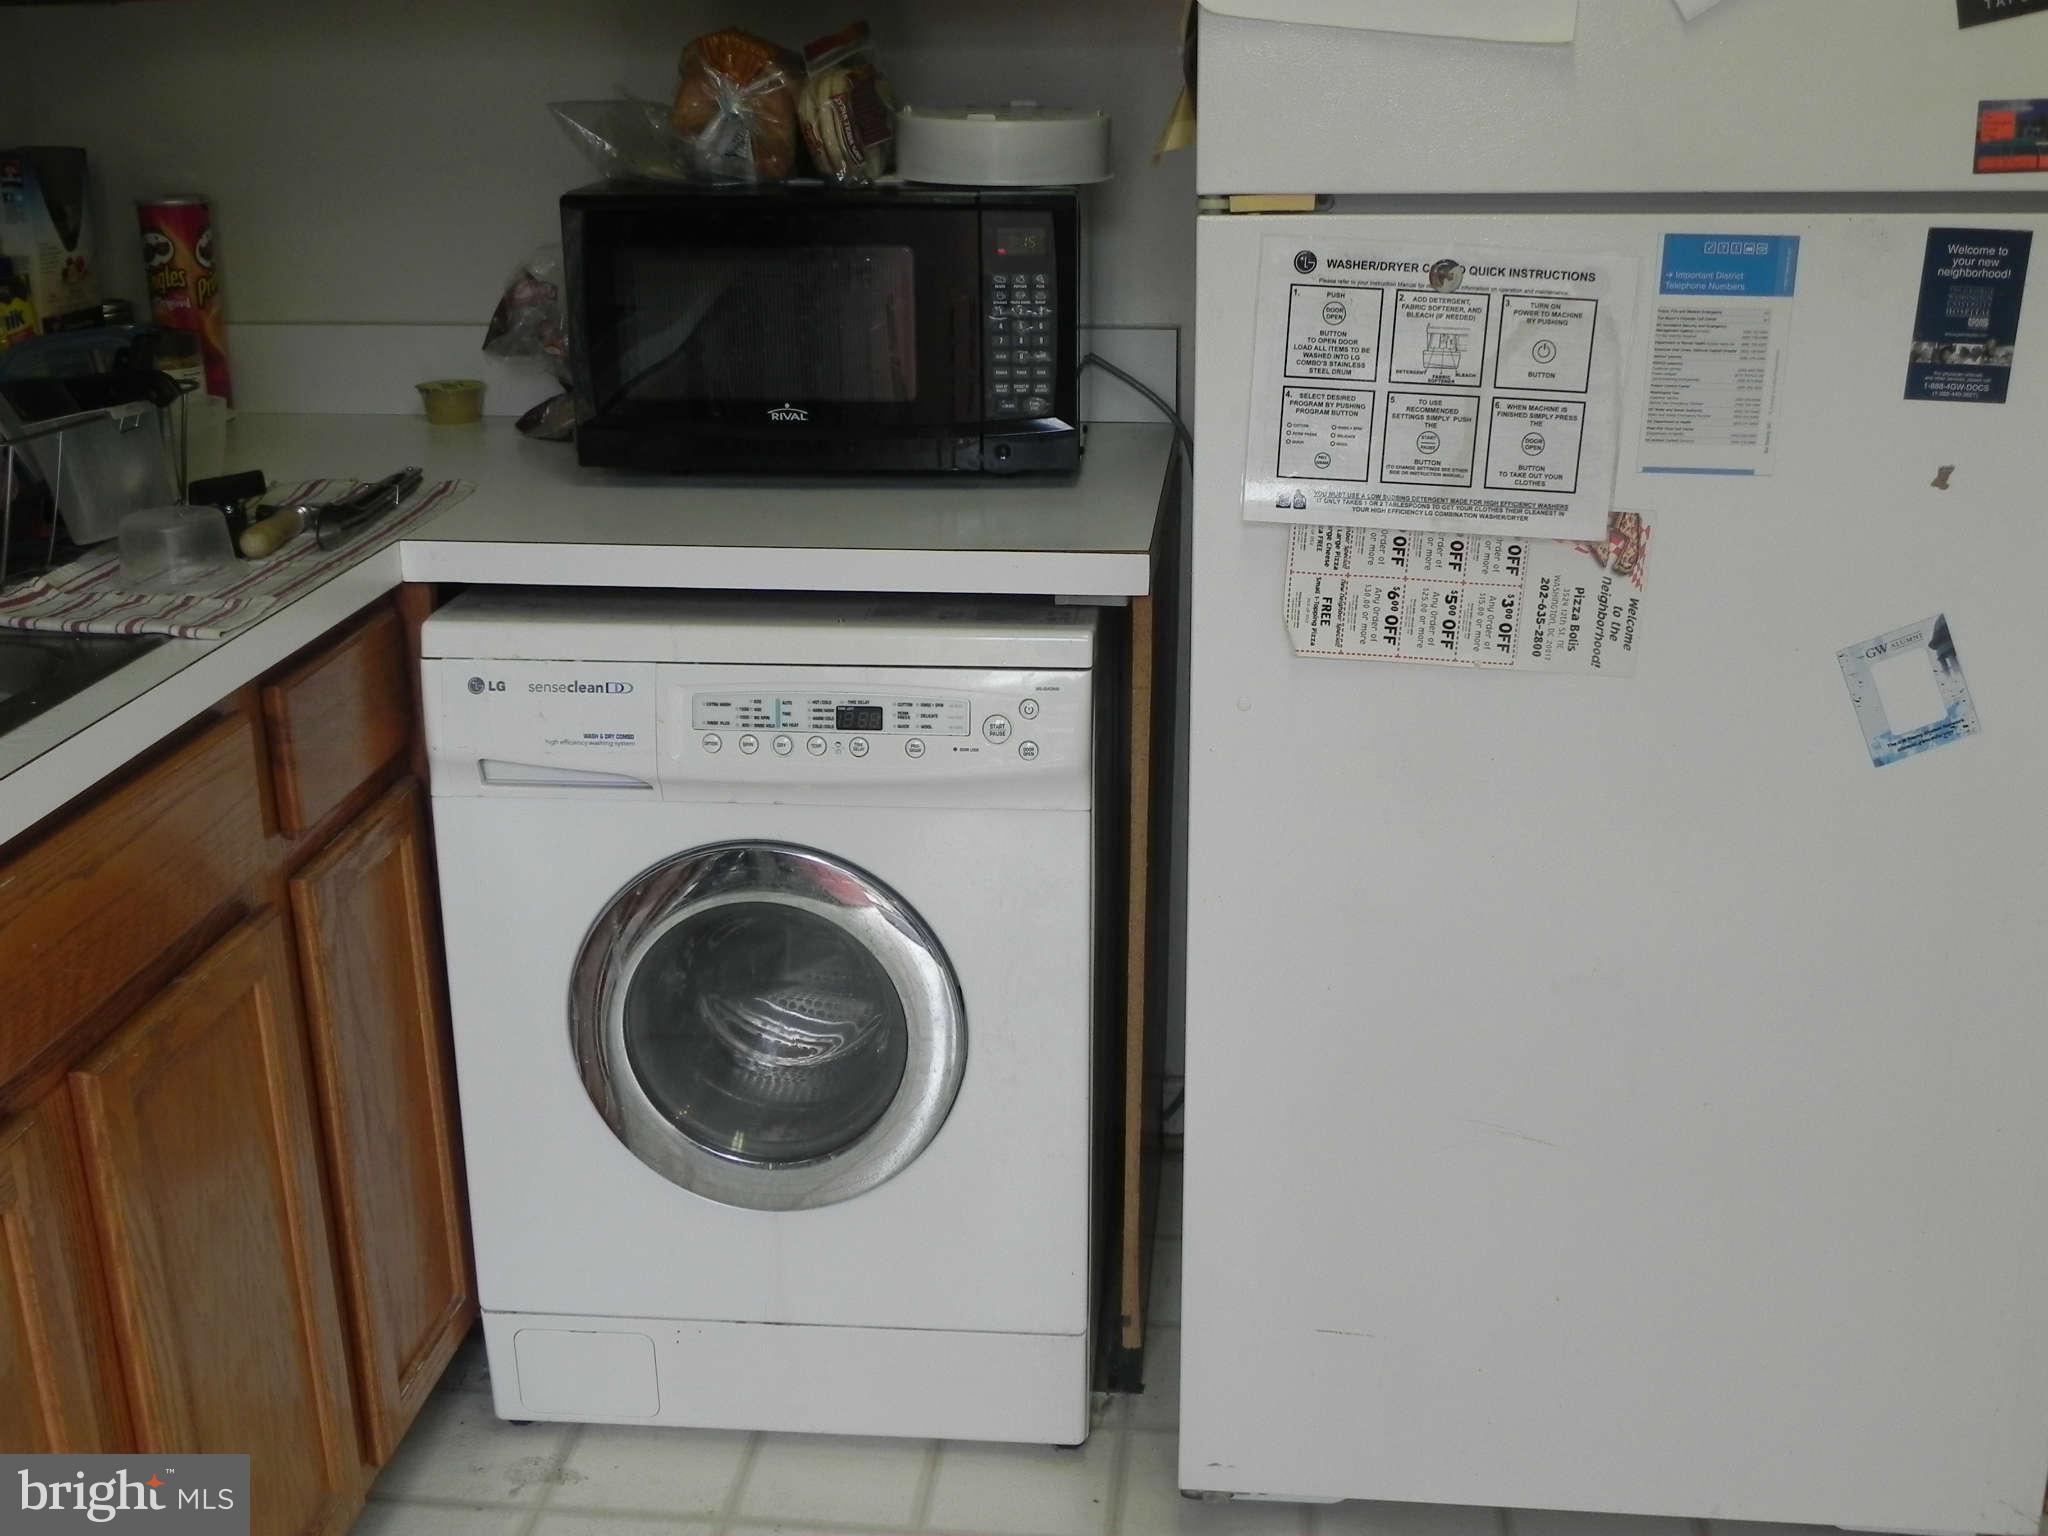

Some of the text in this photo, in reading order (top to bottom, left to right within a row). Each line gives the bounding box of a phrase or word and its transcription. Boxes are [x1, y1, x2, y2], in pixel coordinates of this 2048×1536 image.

[1948, 244, 2008, 256] Welcome to
[1326, 258, 1419, 273] WASHER/DRYER
[1469, 265, 1506, 278] QUICK
[1509, 268, 1596, 282] INSTRUCTIONS
[1937, 268, 2012, 280] neighborhood!
[1952, 258, 1975, 268] your
[1666, 282, 1746, 292] Telephone Numbers
[1675, 272, 1744, 281] Important District
[772, 412, 808, 420] RIVAL
[1406, 406, 1459, 414] RECOMMENDED
[1434, 511, 1478, 519] COMBINATION
[1479, 513, 1528, 522] WASHER/DRYER
[1333, 549, 1341, 570] Pizza
[1391, 536, 1406, 567] OFF
[1448, 540, 1464, 572] OFF
[1506, 545, 1522, 576] OFF
[1311, 596, 1320, 627] 1-Topping
[1320, 597, 1332, 626] FREE
[1362, 612, 1368, 620] or
[1370, 588, 1382, 642] Any Order of
[1420, 616, 1426, 624] or
[1428, 592, 1440, 646] Any Order of
[1476, 618, 1482, 628] or
[1484, 596, 1496, 650] Any Order of
[1532, 578, 1550, 658] 202-635-2800
[1568, 586, 1585, 652] Pizza Bolis
[1383, 615, 1398, 646] OFF
[1440, 620, 1456, 650] OFF
[1609, 606, 1624, 642] to the
[1623, 598, 1640, 652] Welcome
[1310, 628, 1318, 646] Pizza
[1416, 626, 1424, 648] more
[1473, 630, 1481, 652] more
[1497, 623, 1512, 654] OFF
[1866, 632, 1924, 660] GW ALUMNI
[489, 680, 604, 694] LG senseclean
[545, 738, 559, 746] high
[560, 739, 588, 747] efficiency
